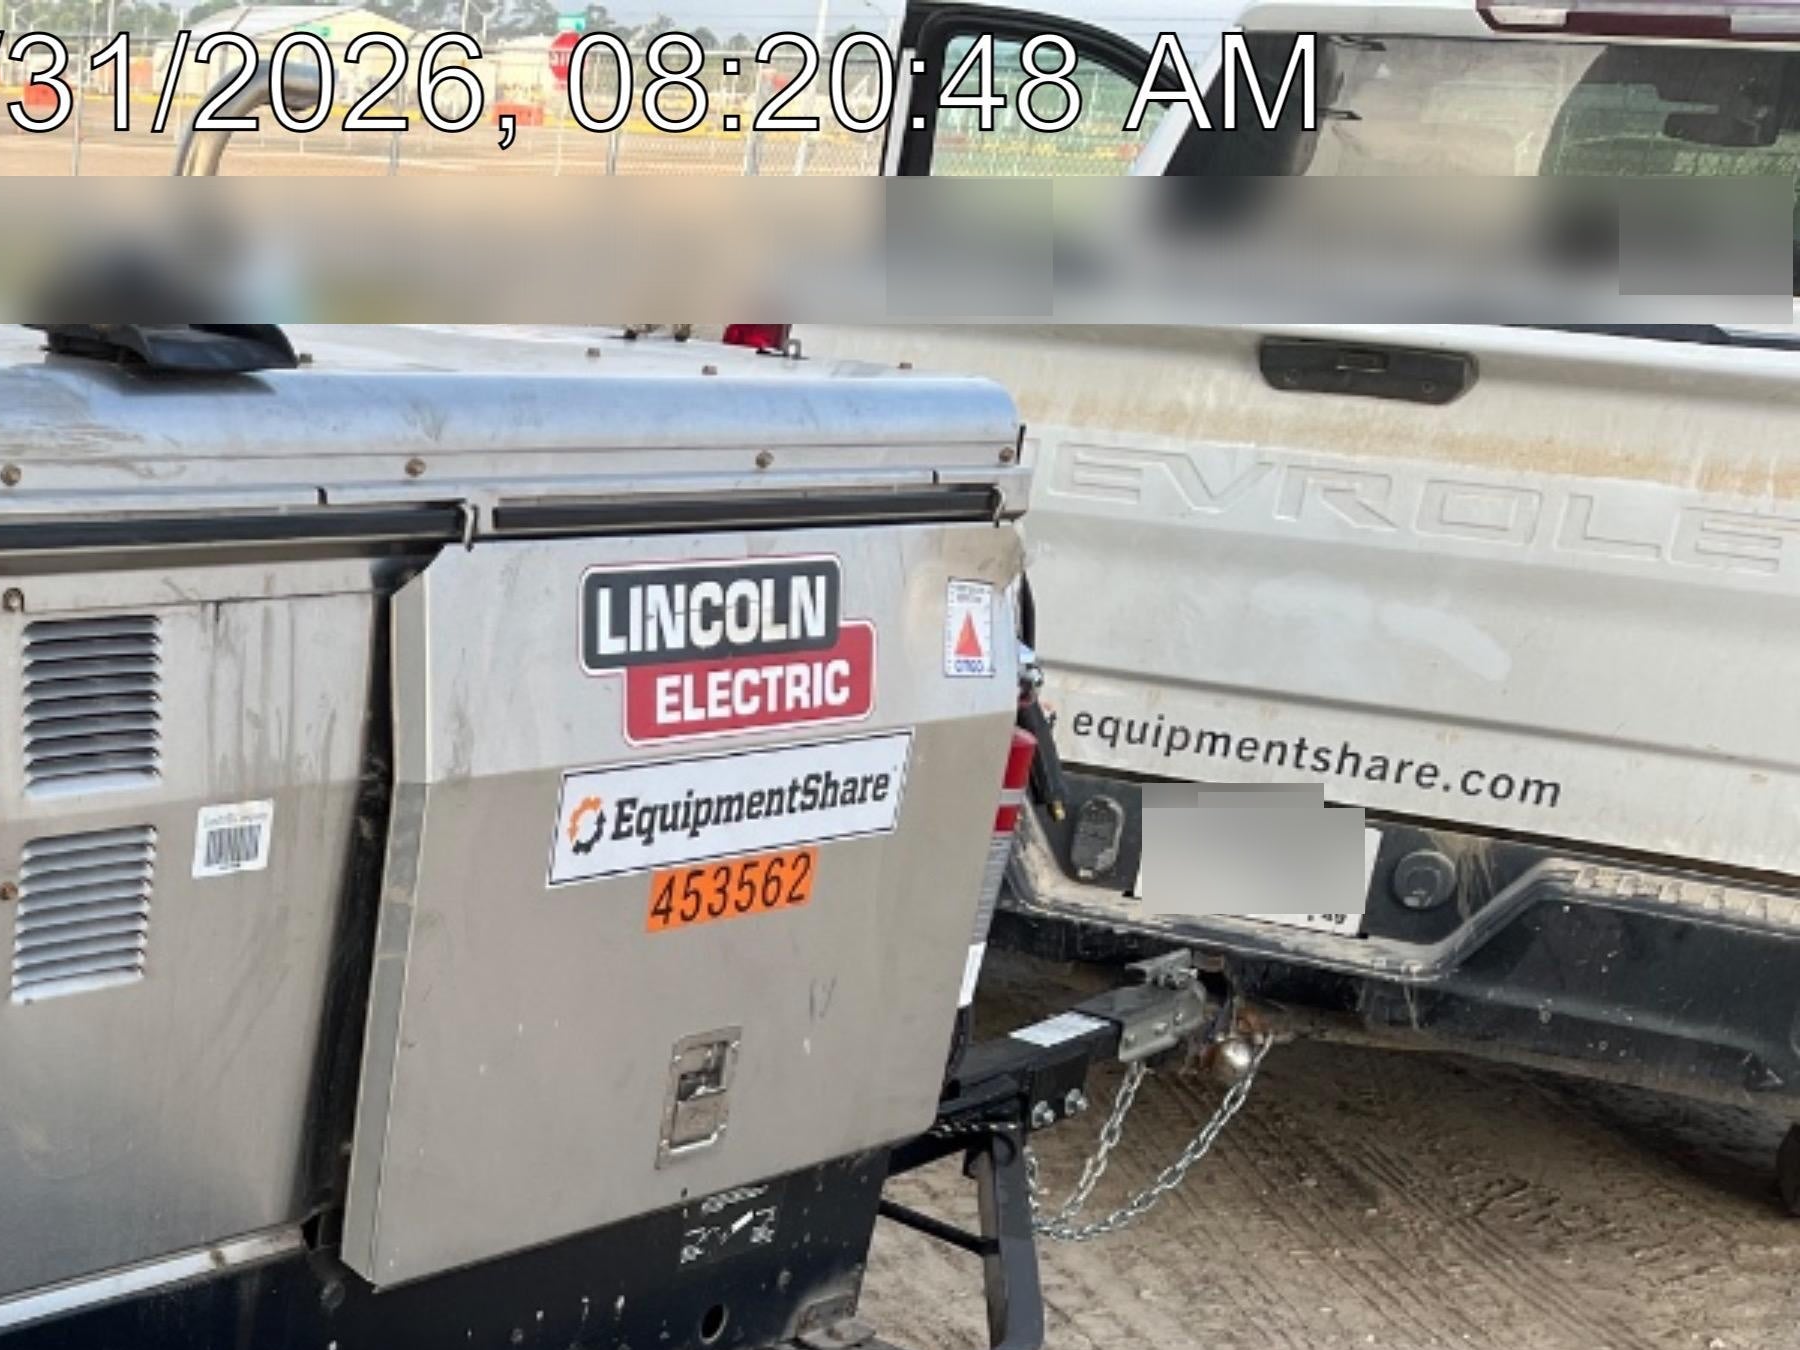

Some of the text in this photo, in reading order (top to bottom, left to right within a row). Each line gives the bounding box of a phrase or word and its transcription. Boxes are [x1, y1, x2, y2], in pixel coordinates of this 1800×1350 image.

[1029, 438, 1800, 577] EVROLE
[595, 574, 827, 656] LINCOLN
[655, 659, 851, 725] ELECTRIC
[1072, 710, 1562, 808] equipmentshare.com
[611, 770, 890, 847] EquipmentShare
[650, 850, 812, 926] 453562
